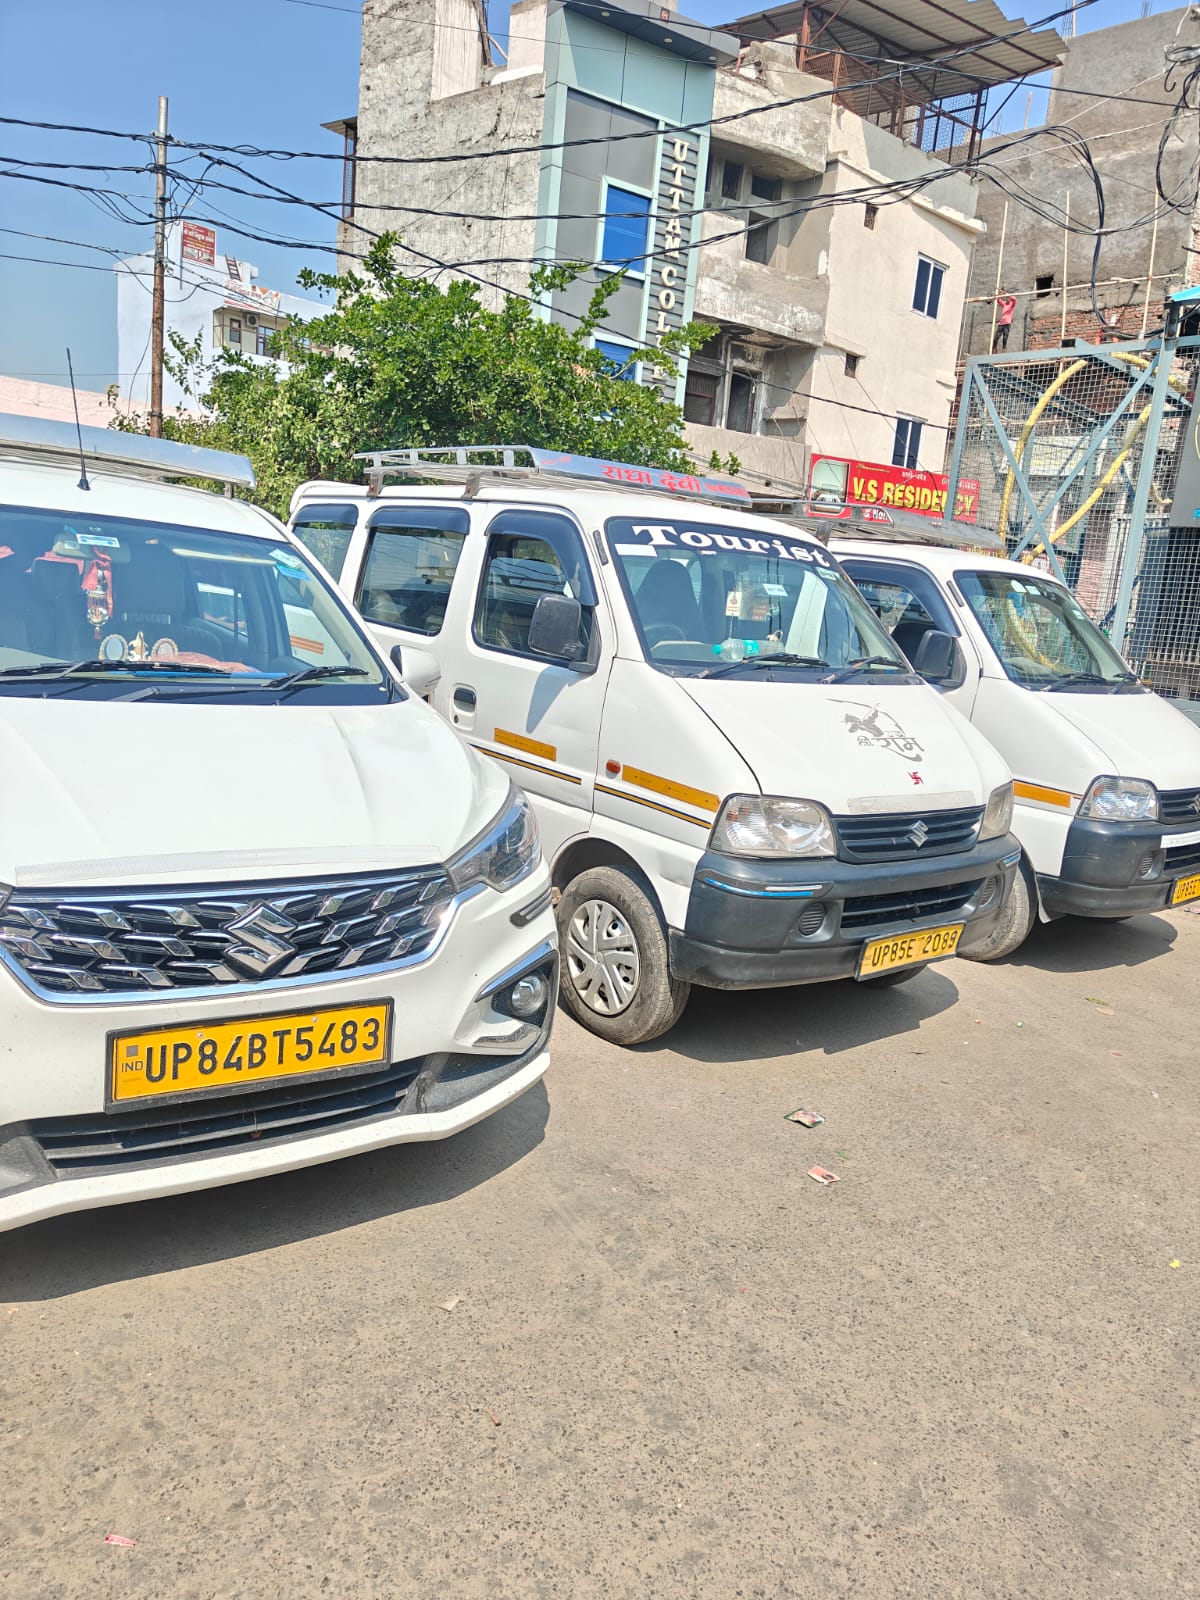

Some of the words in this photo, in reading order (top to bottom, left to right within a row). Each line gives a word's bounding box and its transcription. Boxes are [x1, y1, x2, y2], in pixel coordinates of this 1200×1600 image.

[664, 138, 690, 259] UTTAM
[600, 464, 653, 485] राधा
[658, 470, 702, 493] देवी
[853, 476, 879, 503] V.S
[632, 525, 831, 568] Tourist
[922, 930, 958, 954] 2089
[121, 1060, 144, 1073] IND
[145, 1017, 380, 1083] UP84BT5483
